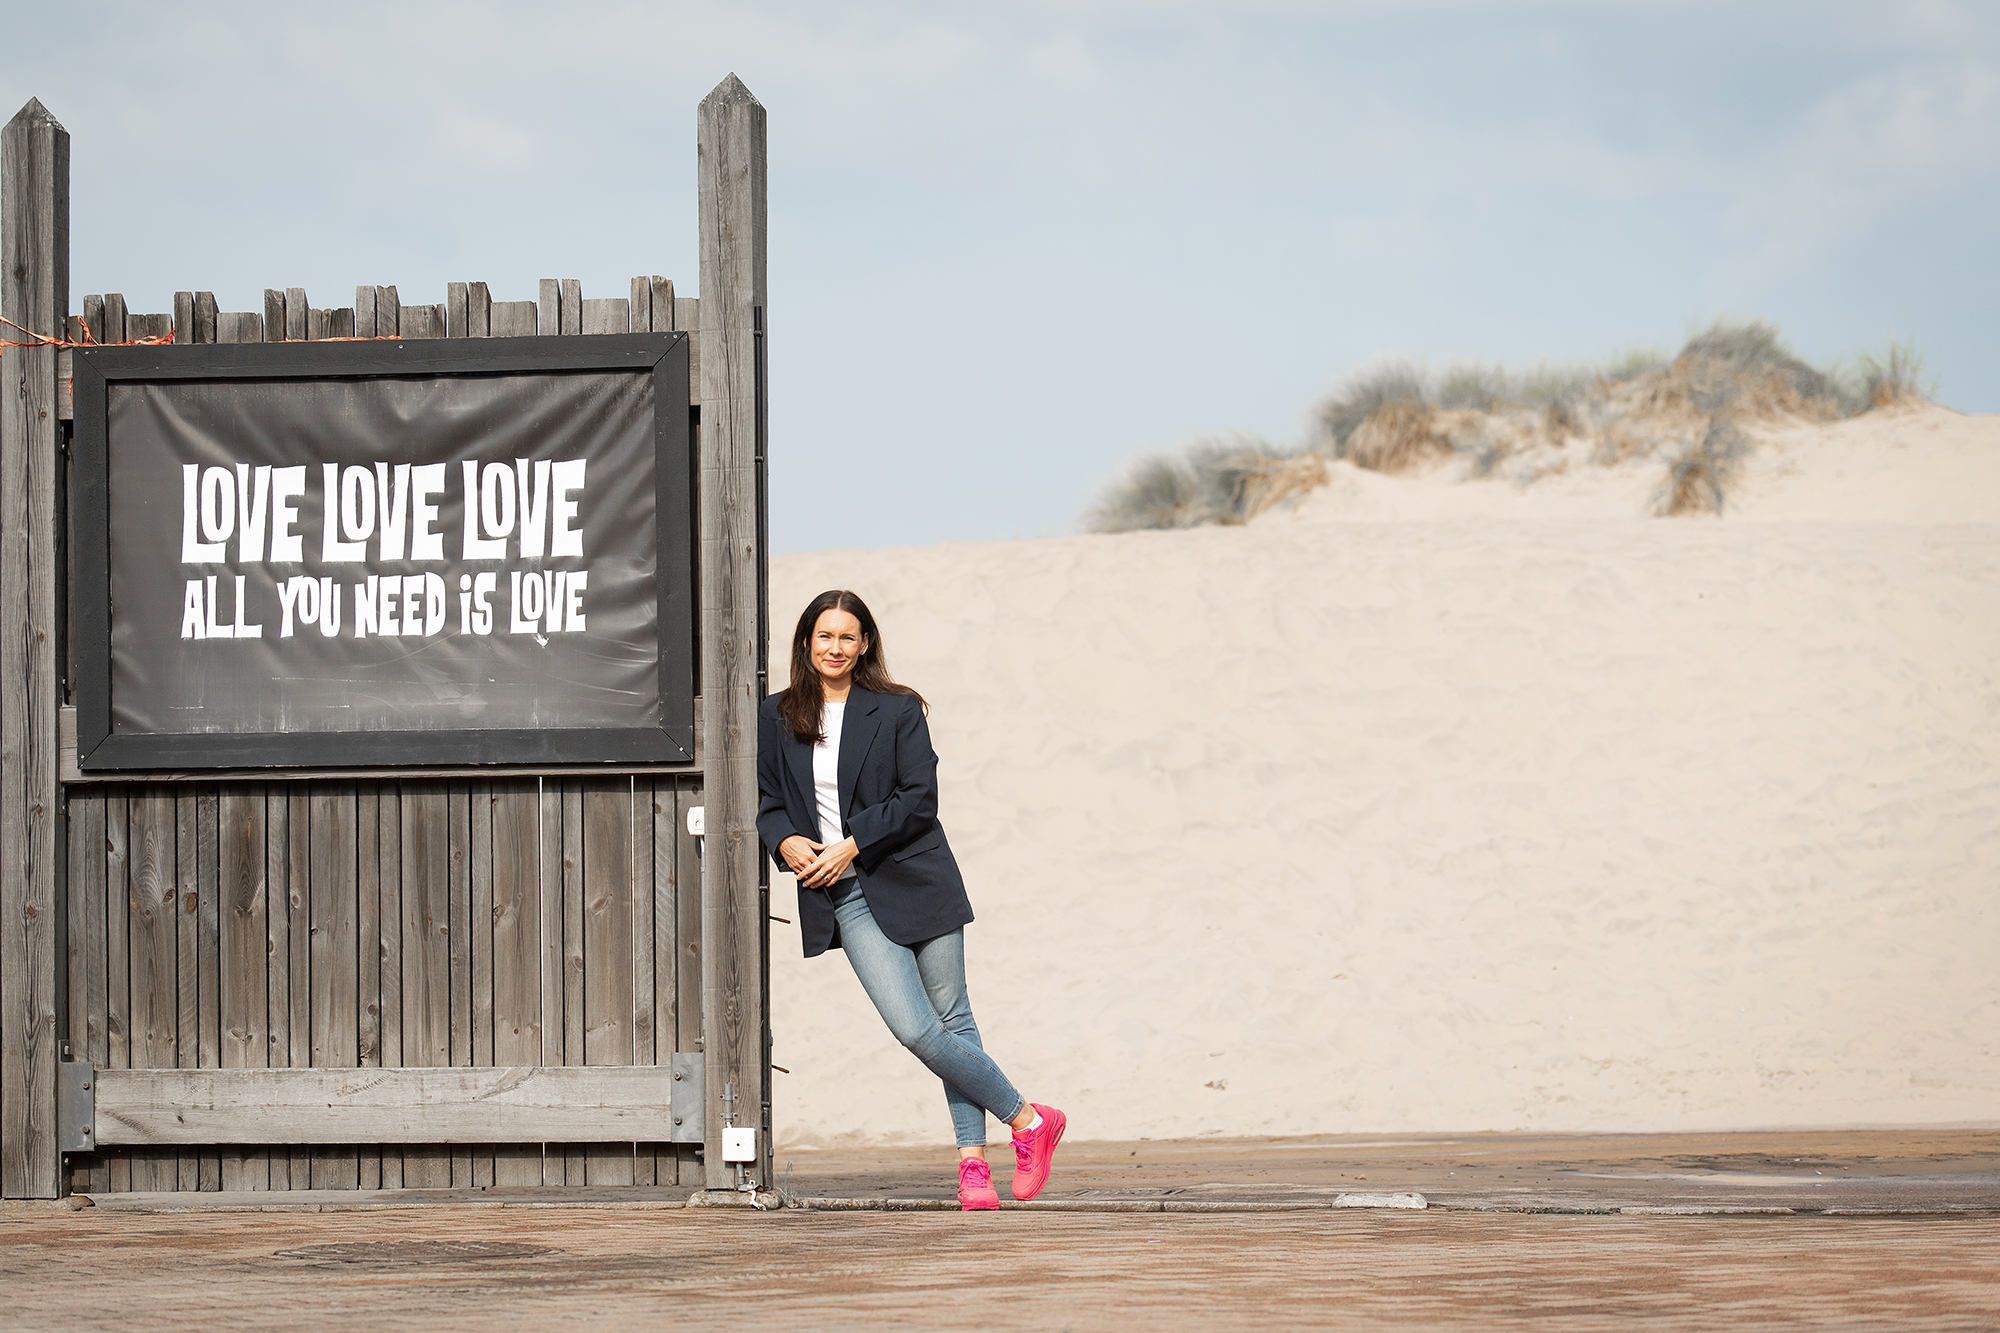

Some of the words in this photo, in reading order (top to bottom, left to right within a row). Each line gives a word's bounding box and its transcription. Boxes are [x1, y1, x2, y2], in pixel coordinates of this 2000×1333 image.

[181, 463, 307, 563] LOVE
[321, 461, 446, 562] LOVE
[461, 457, 587, 561] LOVE
[180, 575, 262, 641] ALL
[276, 575, 341, 639] YOU
[354, 572, 446, 639] NEED
[509, 570, 589, 634] LOVE
